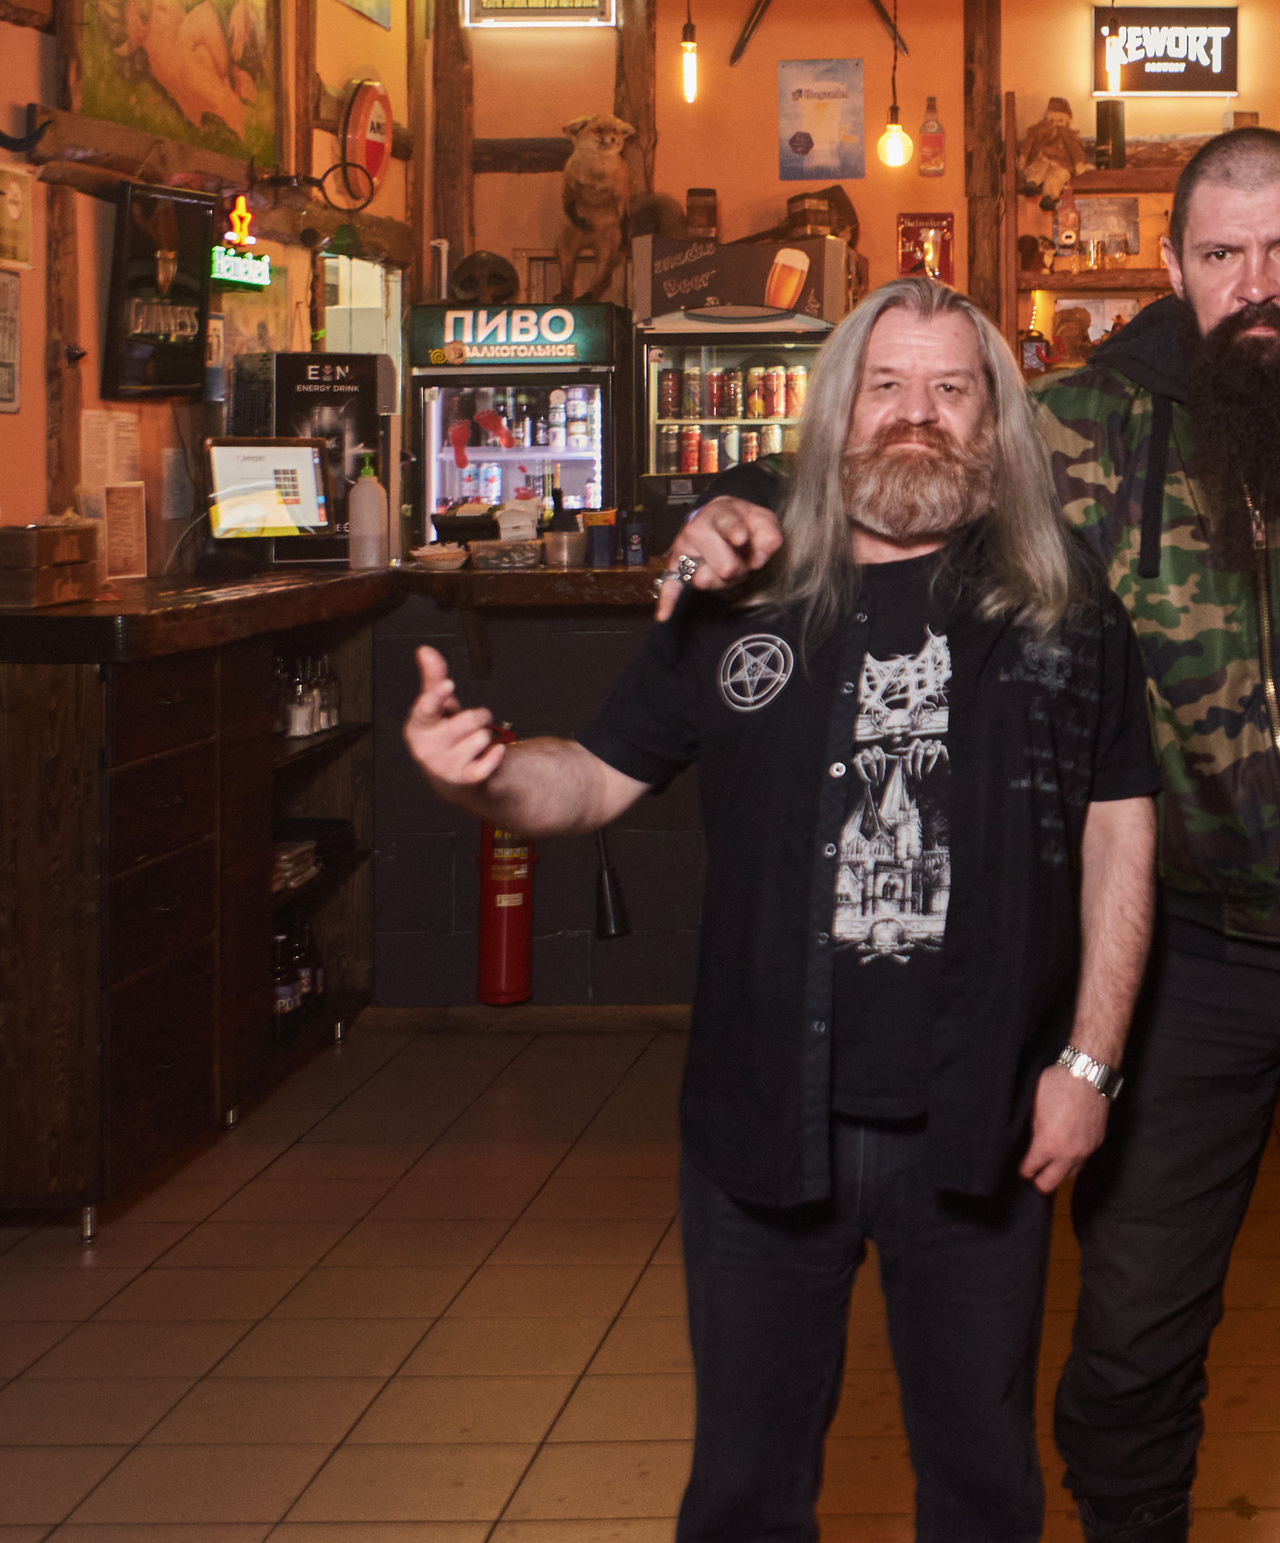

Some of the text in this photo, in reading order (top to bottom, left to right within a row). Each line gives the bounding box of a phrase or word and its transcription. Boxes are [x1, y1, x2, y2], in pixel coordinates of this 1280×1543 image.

[443, 308, 575, 343] ПИВО
[464, 343, 577, 359] ЗАЛКОГОЛЬНОЕ
[296, 384, 360, 392] ENERGY DRINK
